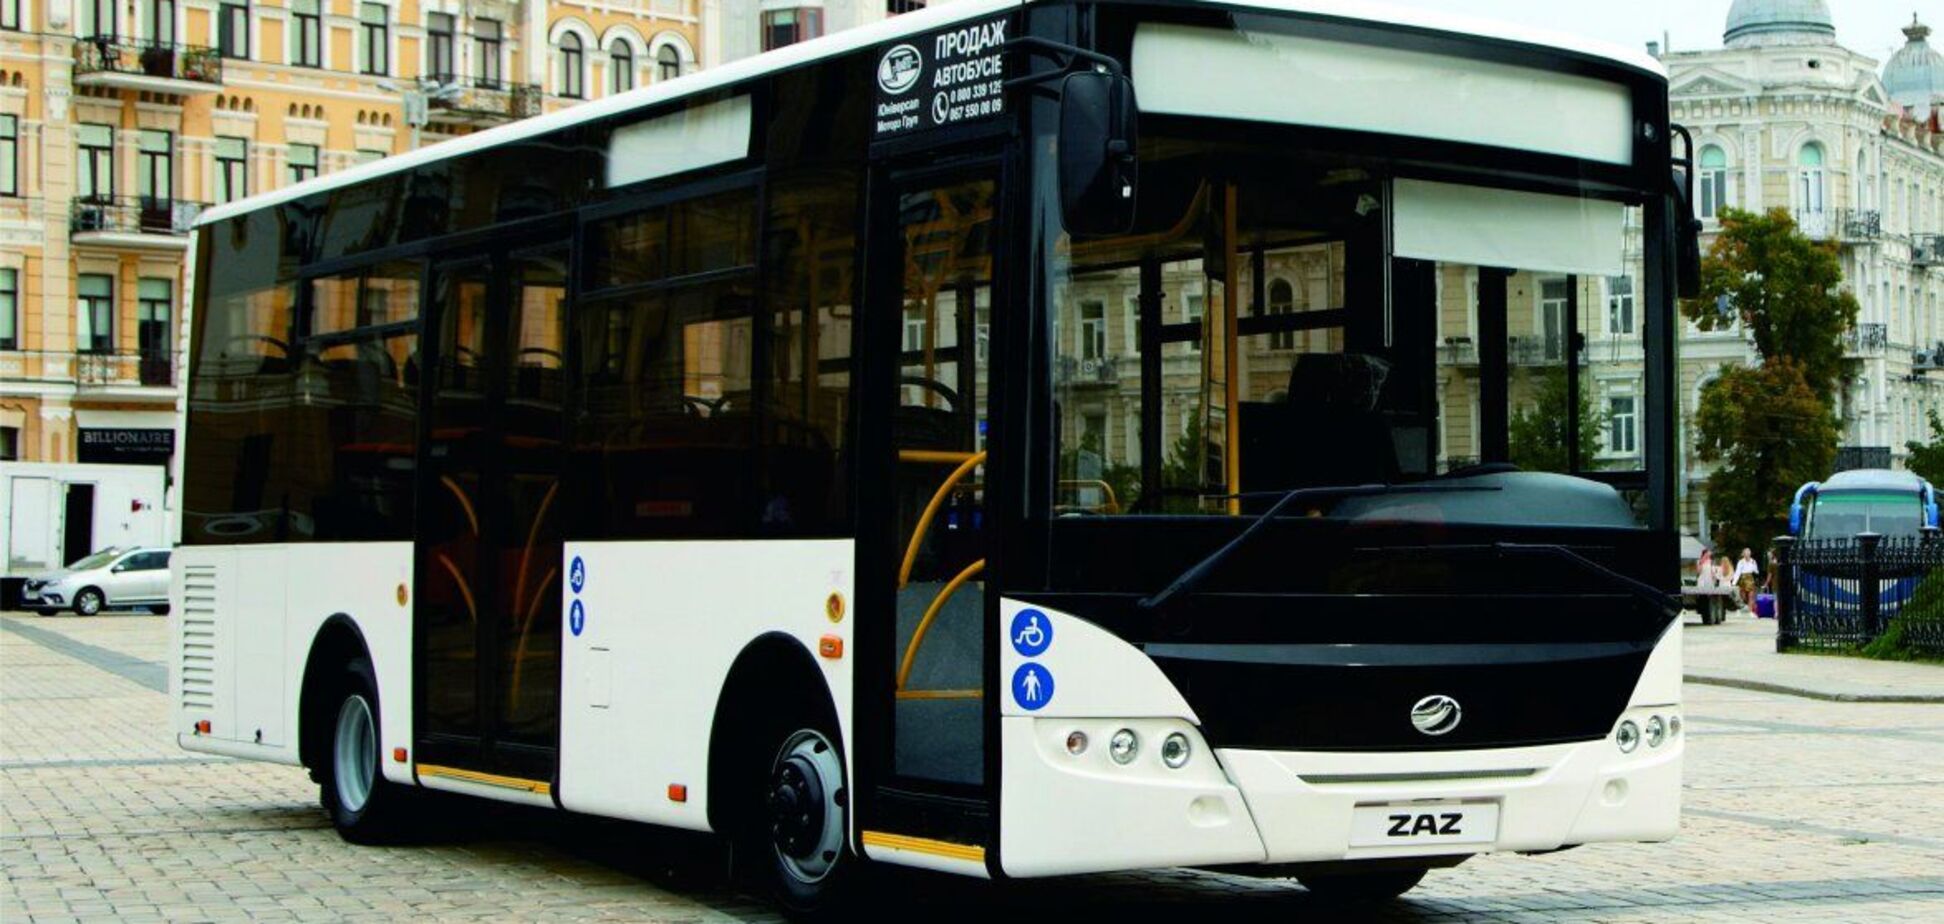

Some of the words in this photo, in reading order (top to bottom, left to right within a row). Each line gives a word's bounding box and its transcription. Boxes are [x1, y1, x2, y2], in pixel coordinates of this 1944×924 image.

[935, 19, 1007, 60] ПРОДАЖ
[950, 90, 956, 104] 0
[83, 431, 171, 444] BILLIONAIRE
[387, 813, 463, 836] ZAZ
